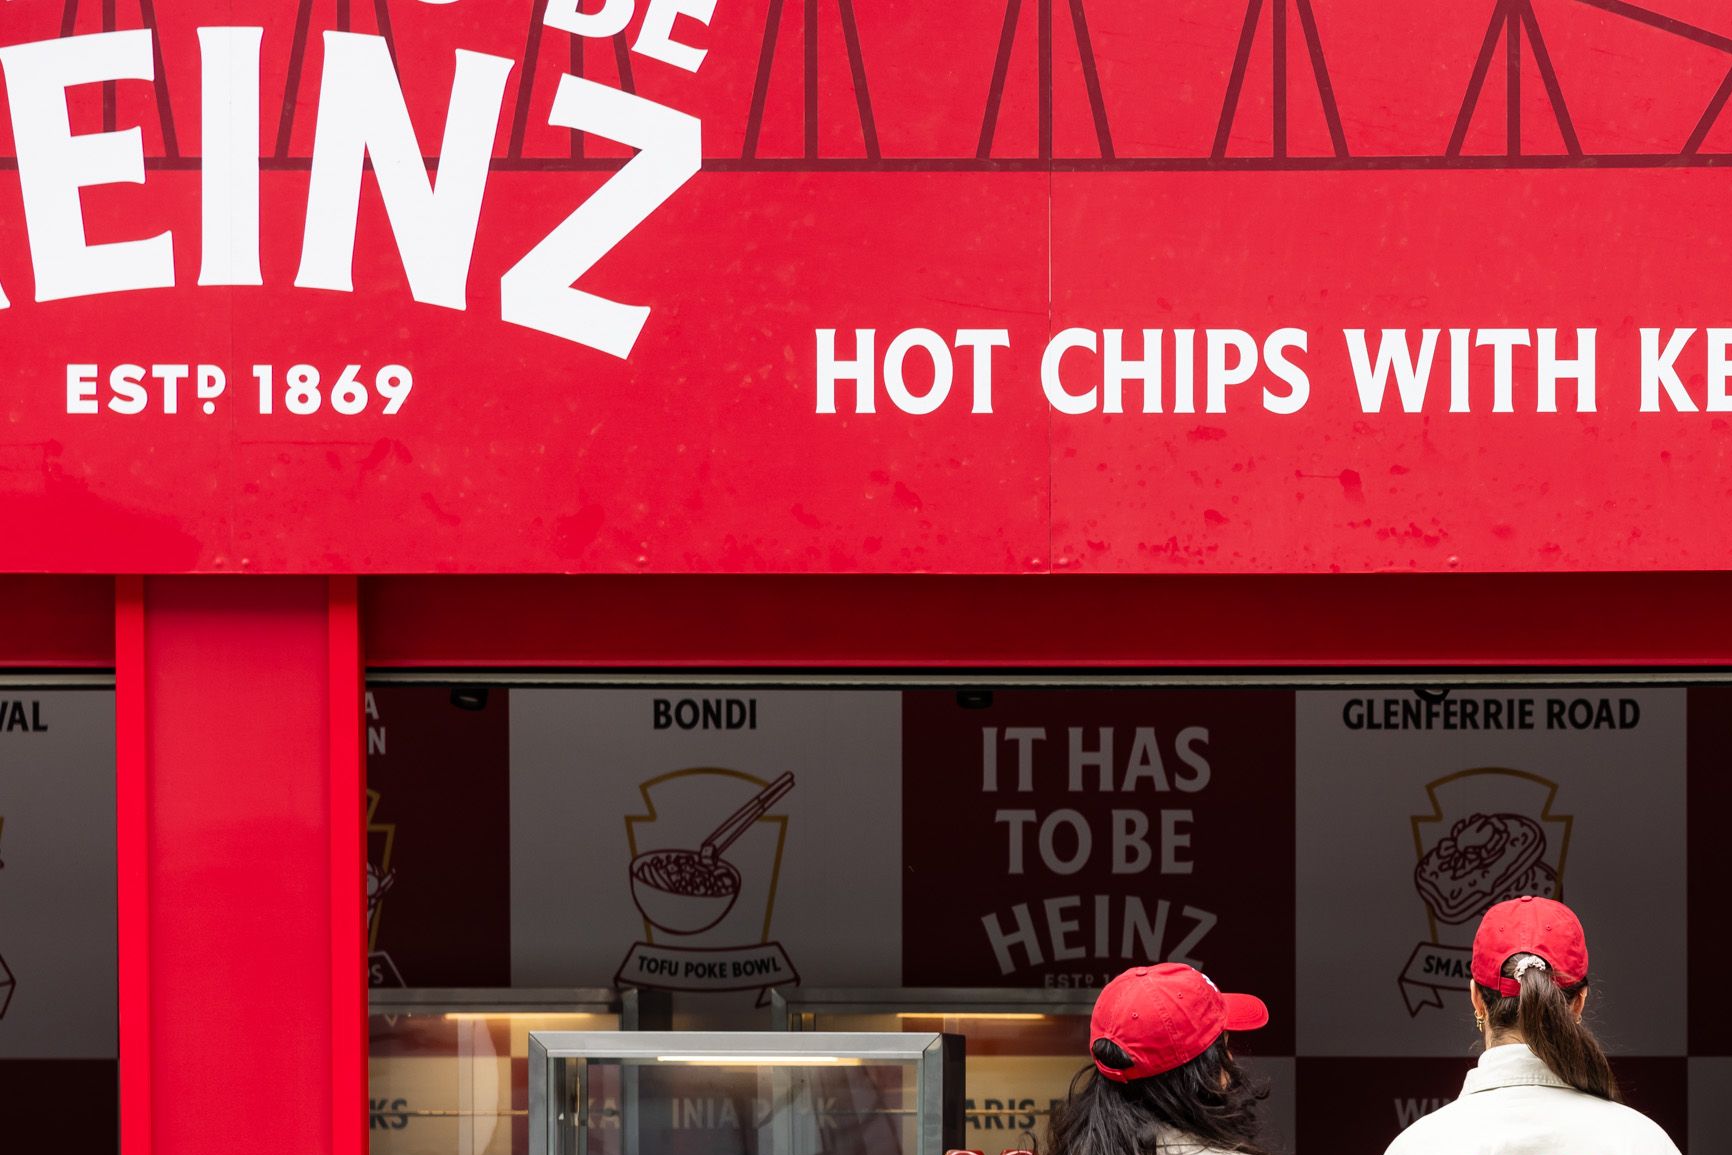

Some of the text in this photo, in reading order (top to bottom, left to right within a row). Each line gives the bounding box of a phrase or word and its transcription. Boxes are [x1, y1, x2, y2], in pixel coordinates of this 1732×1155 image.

[0, 27, 702, 360] EINZ
[253, 364, 414, 415] 1869
[814, 327, 1010, 415] HOT
[1040, 327, 1310, 415] CHIPS
[1342, 327, 1597, 413] WITH
[653, 698, 758, 730] BONDI
[1342, 697, 1640, 731] GLENFERRIE ROAD
[981, 726, 1212, 793] IT HAS
[995, 808, 1194, 875] TO BE
[638, 955, 782, 978] TOFU POKE BOWL
[981, 894, 1217, 976] HEINZ
